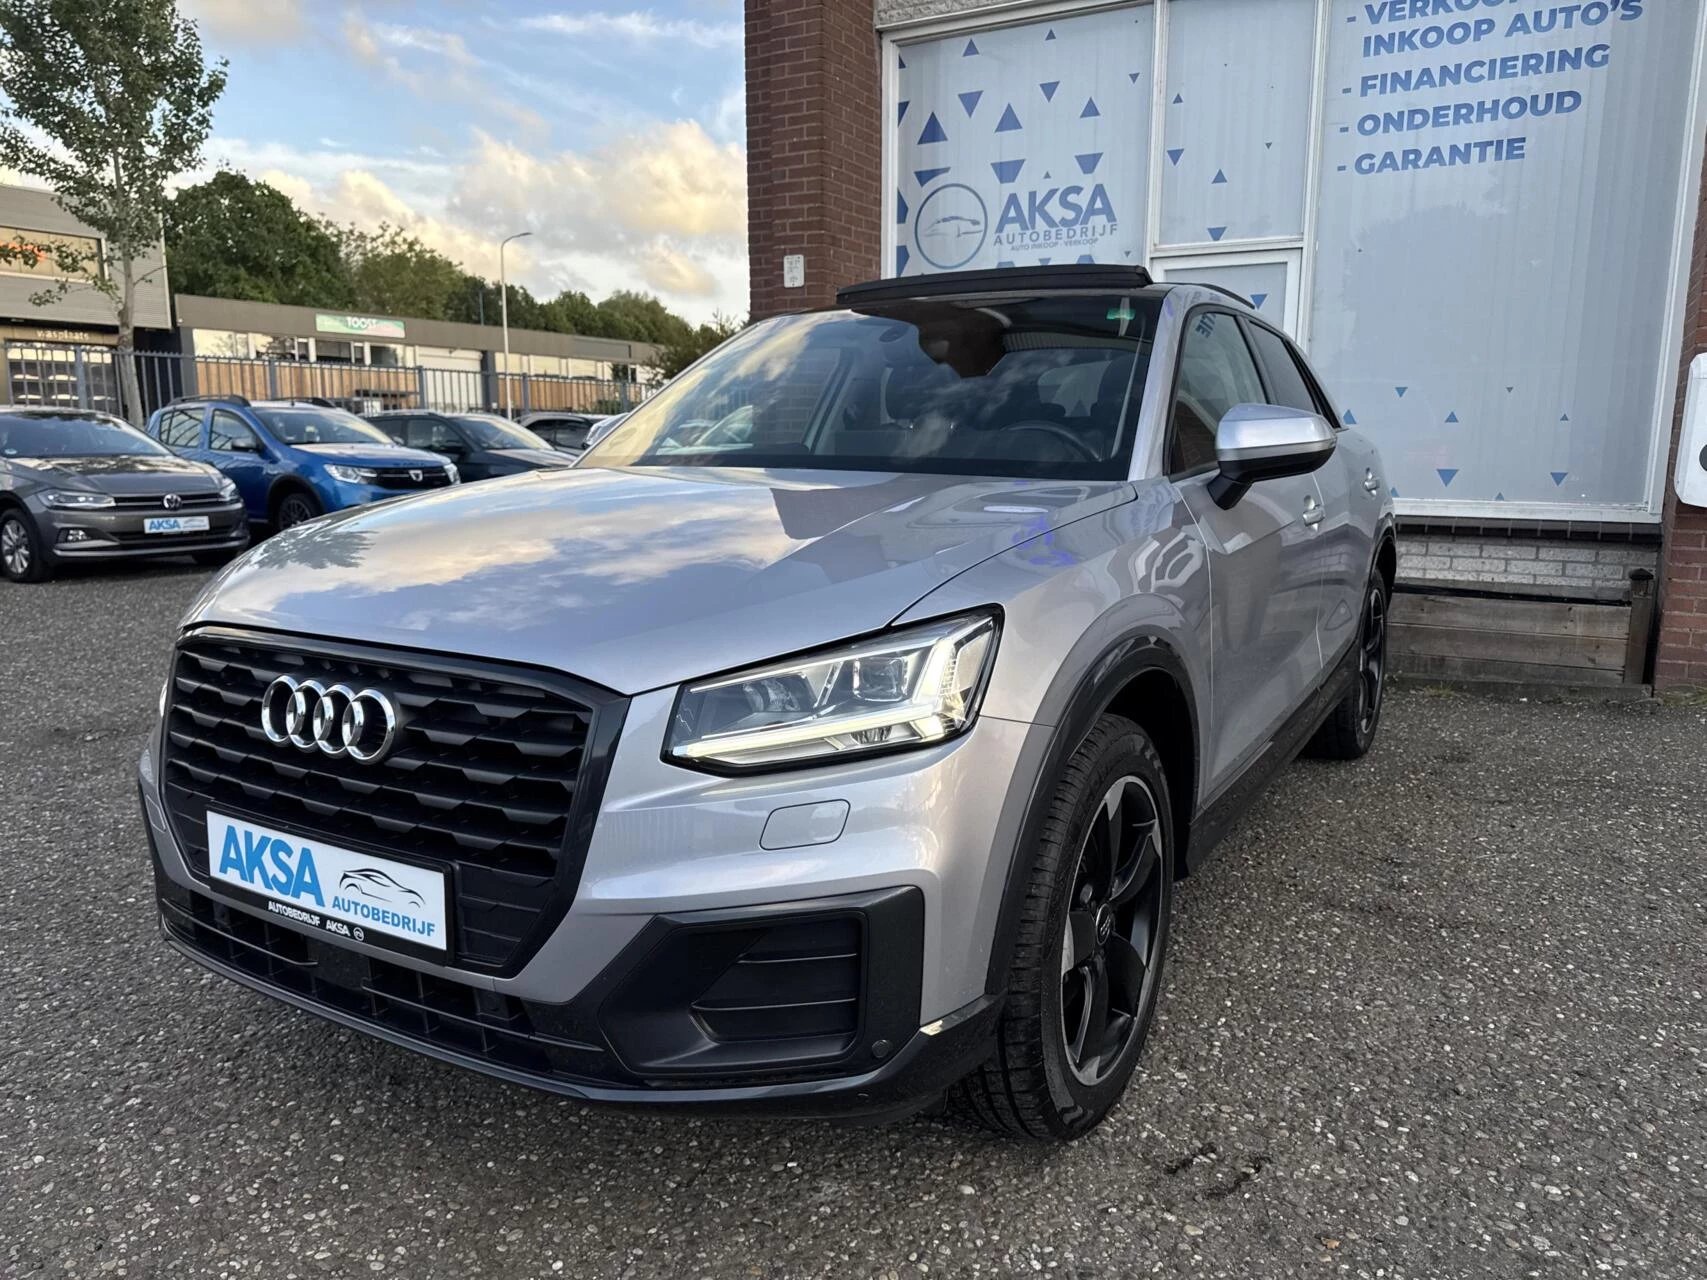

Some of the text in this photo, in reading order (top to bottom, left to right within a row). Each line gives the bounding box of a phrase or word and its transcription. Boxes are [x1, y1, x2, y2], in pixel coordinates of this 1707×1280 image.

[1362, 0, 1643, 57] INKOOP AUTO'S
[1359, 43, 1611, 97] FINANCIERING
[1357, 90, 1583, 137] ONDERHOUD
[1354, 137, 1527, 175] GARANTIE
[995, 183, 1117, 234] AKSA
[993, 224, 1118, 246] AUTOBEDRIJF
[149, 519, 181, 530] AKSA
[219, 824, 325, 908] AKSA
[267, 900, 351, 937] AUTOBEDRIJF AKSA
[332, 896, 435, 937] AUTOBEDRIJF
